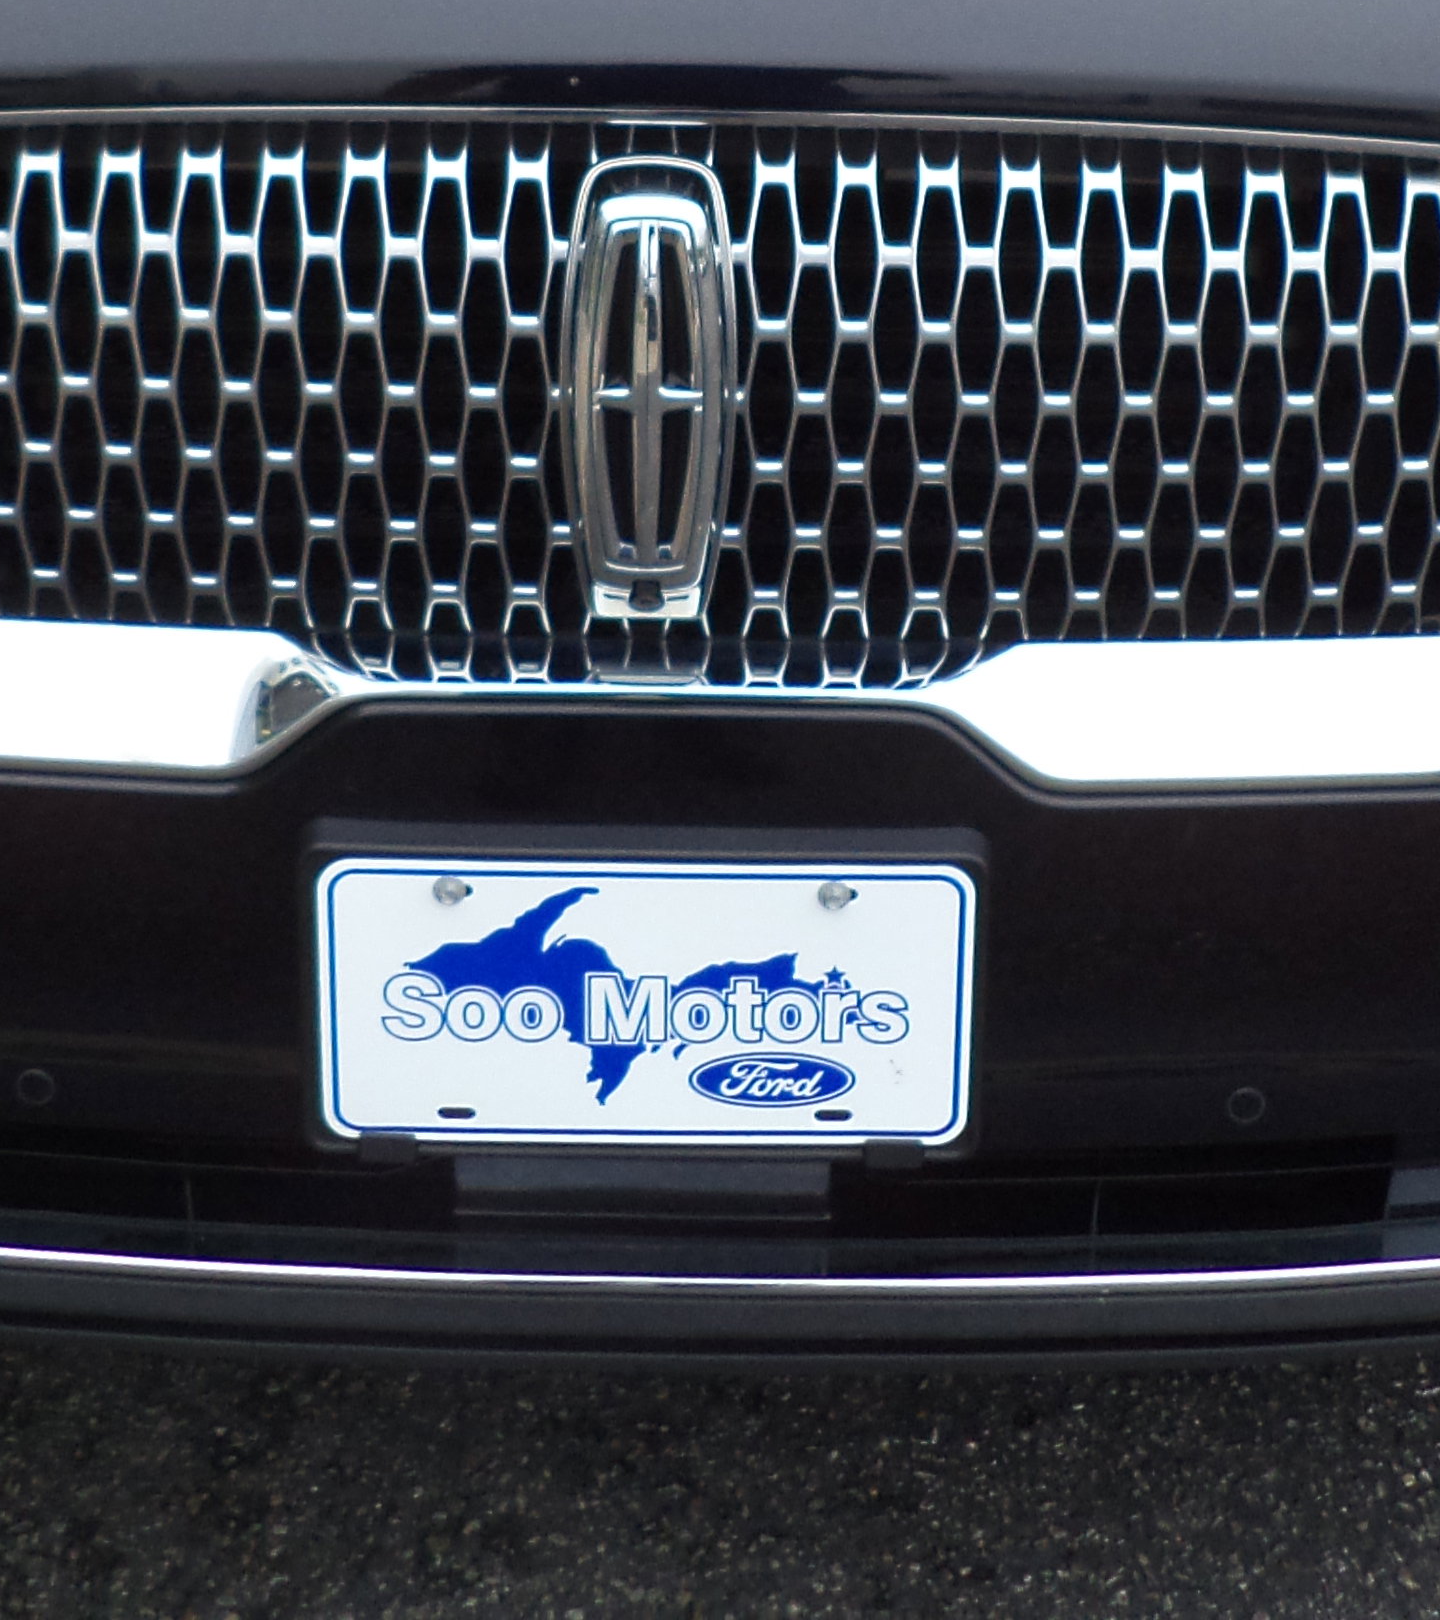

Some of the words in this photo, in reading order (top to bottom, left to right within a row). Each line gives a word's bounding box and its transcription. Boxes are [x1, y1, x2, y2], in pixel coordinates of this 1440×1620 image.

[381, 972, 562, 1042] Soo
[587, 974, 910, 1044] Motors
[720, 1061, 824, 1099] Ford
